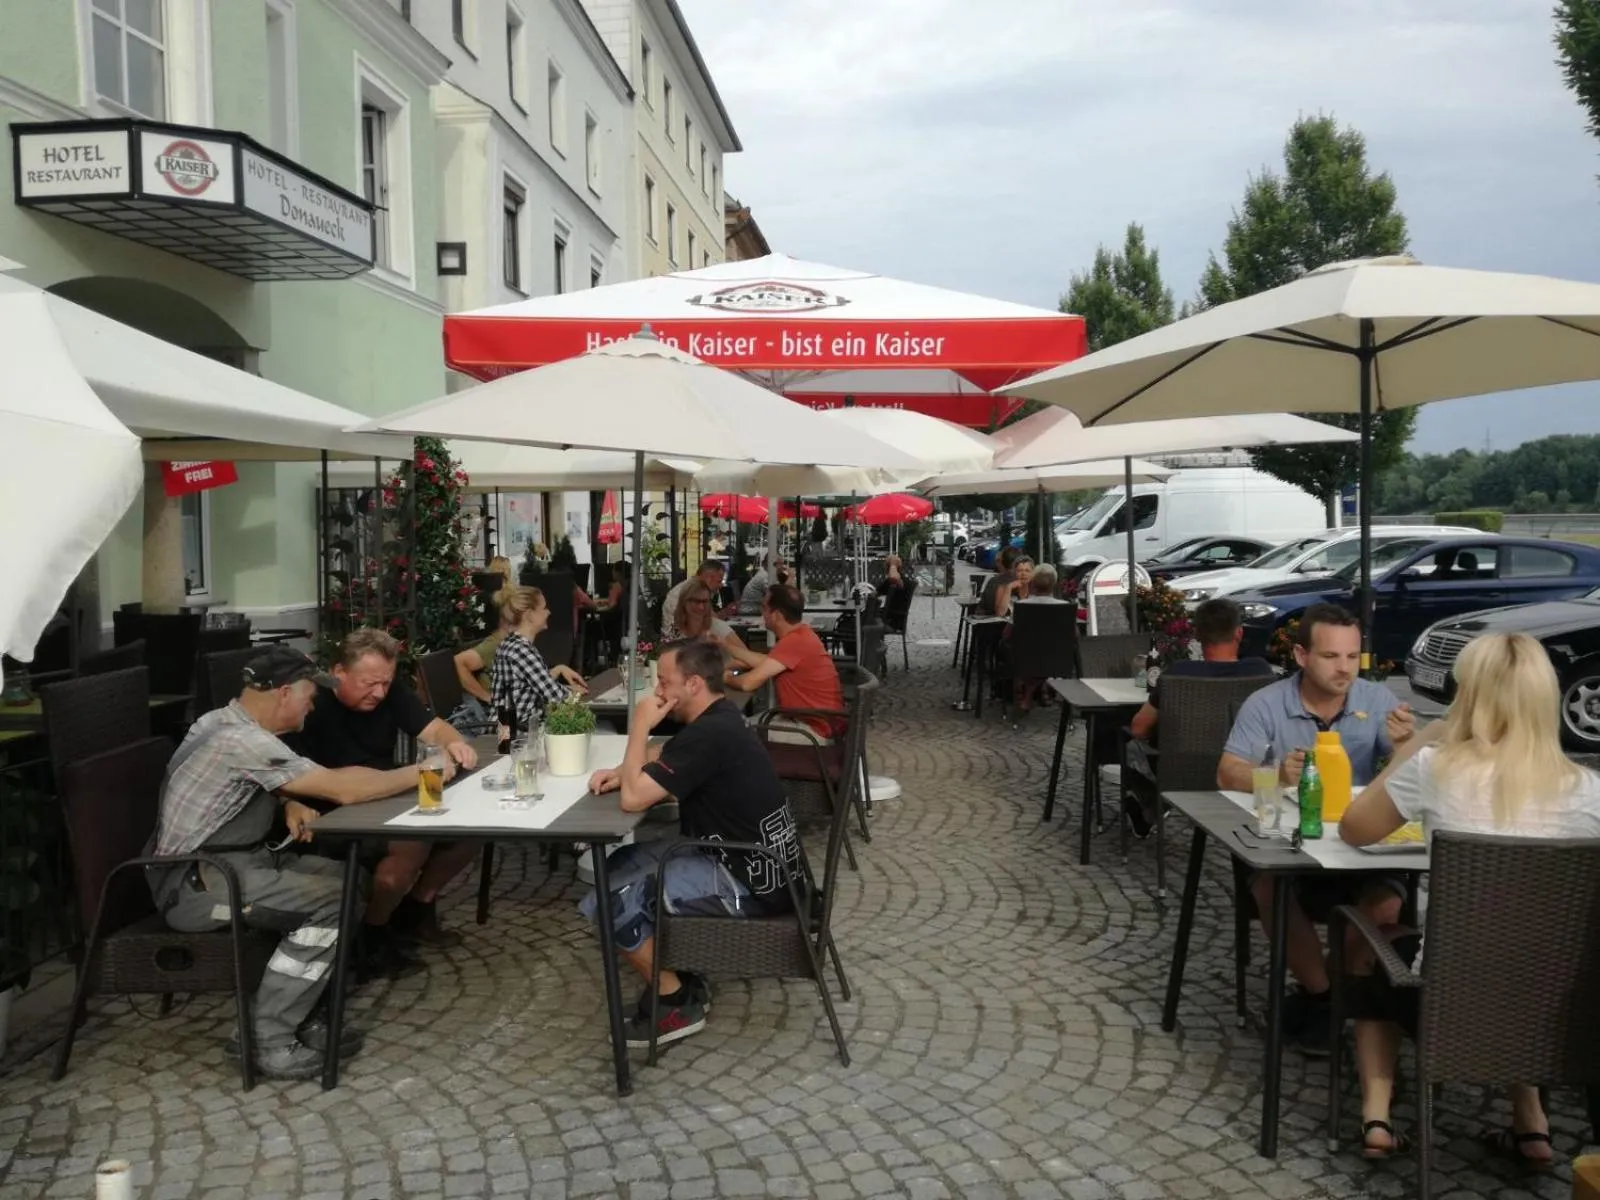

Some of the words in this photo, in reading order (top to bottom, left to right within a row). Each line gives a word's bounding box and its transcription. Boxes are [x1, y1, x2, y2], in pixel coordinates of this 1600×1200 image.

[43, 145, 105, 164] HOTEL
[27, 166, 122, 183] RESTAURANT
[165, 158, 210, 175] KAISER
[248, 159, 288, 190] HOTEL
[302, 184, 369, 227] RESTAURANT
[280, 193, 346, 242] Donaueck
[714, 292, 826, 304] KAISER
[688, 331, 758, 357] Kaiser
[782, 330, 823, 357] bist
[831, 331, 866, 357] ein
[875, 331, 945, 357] Kaiser
